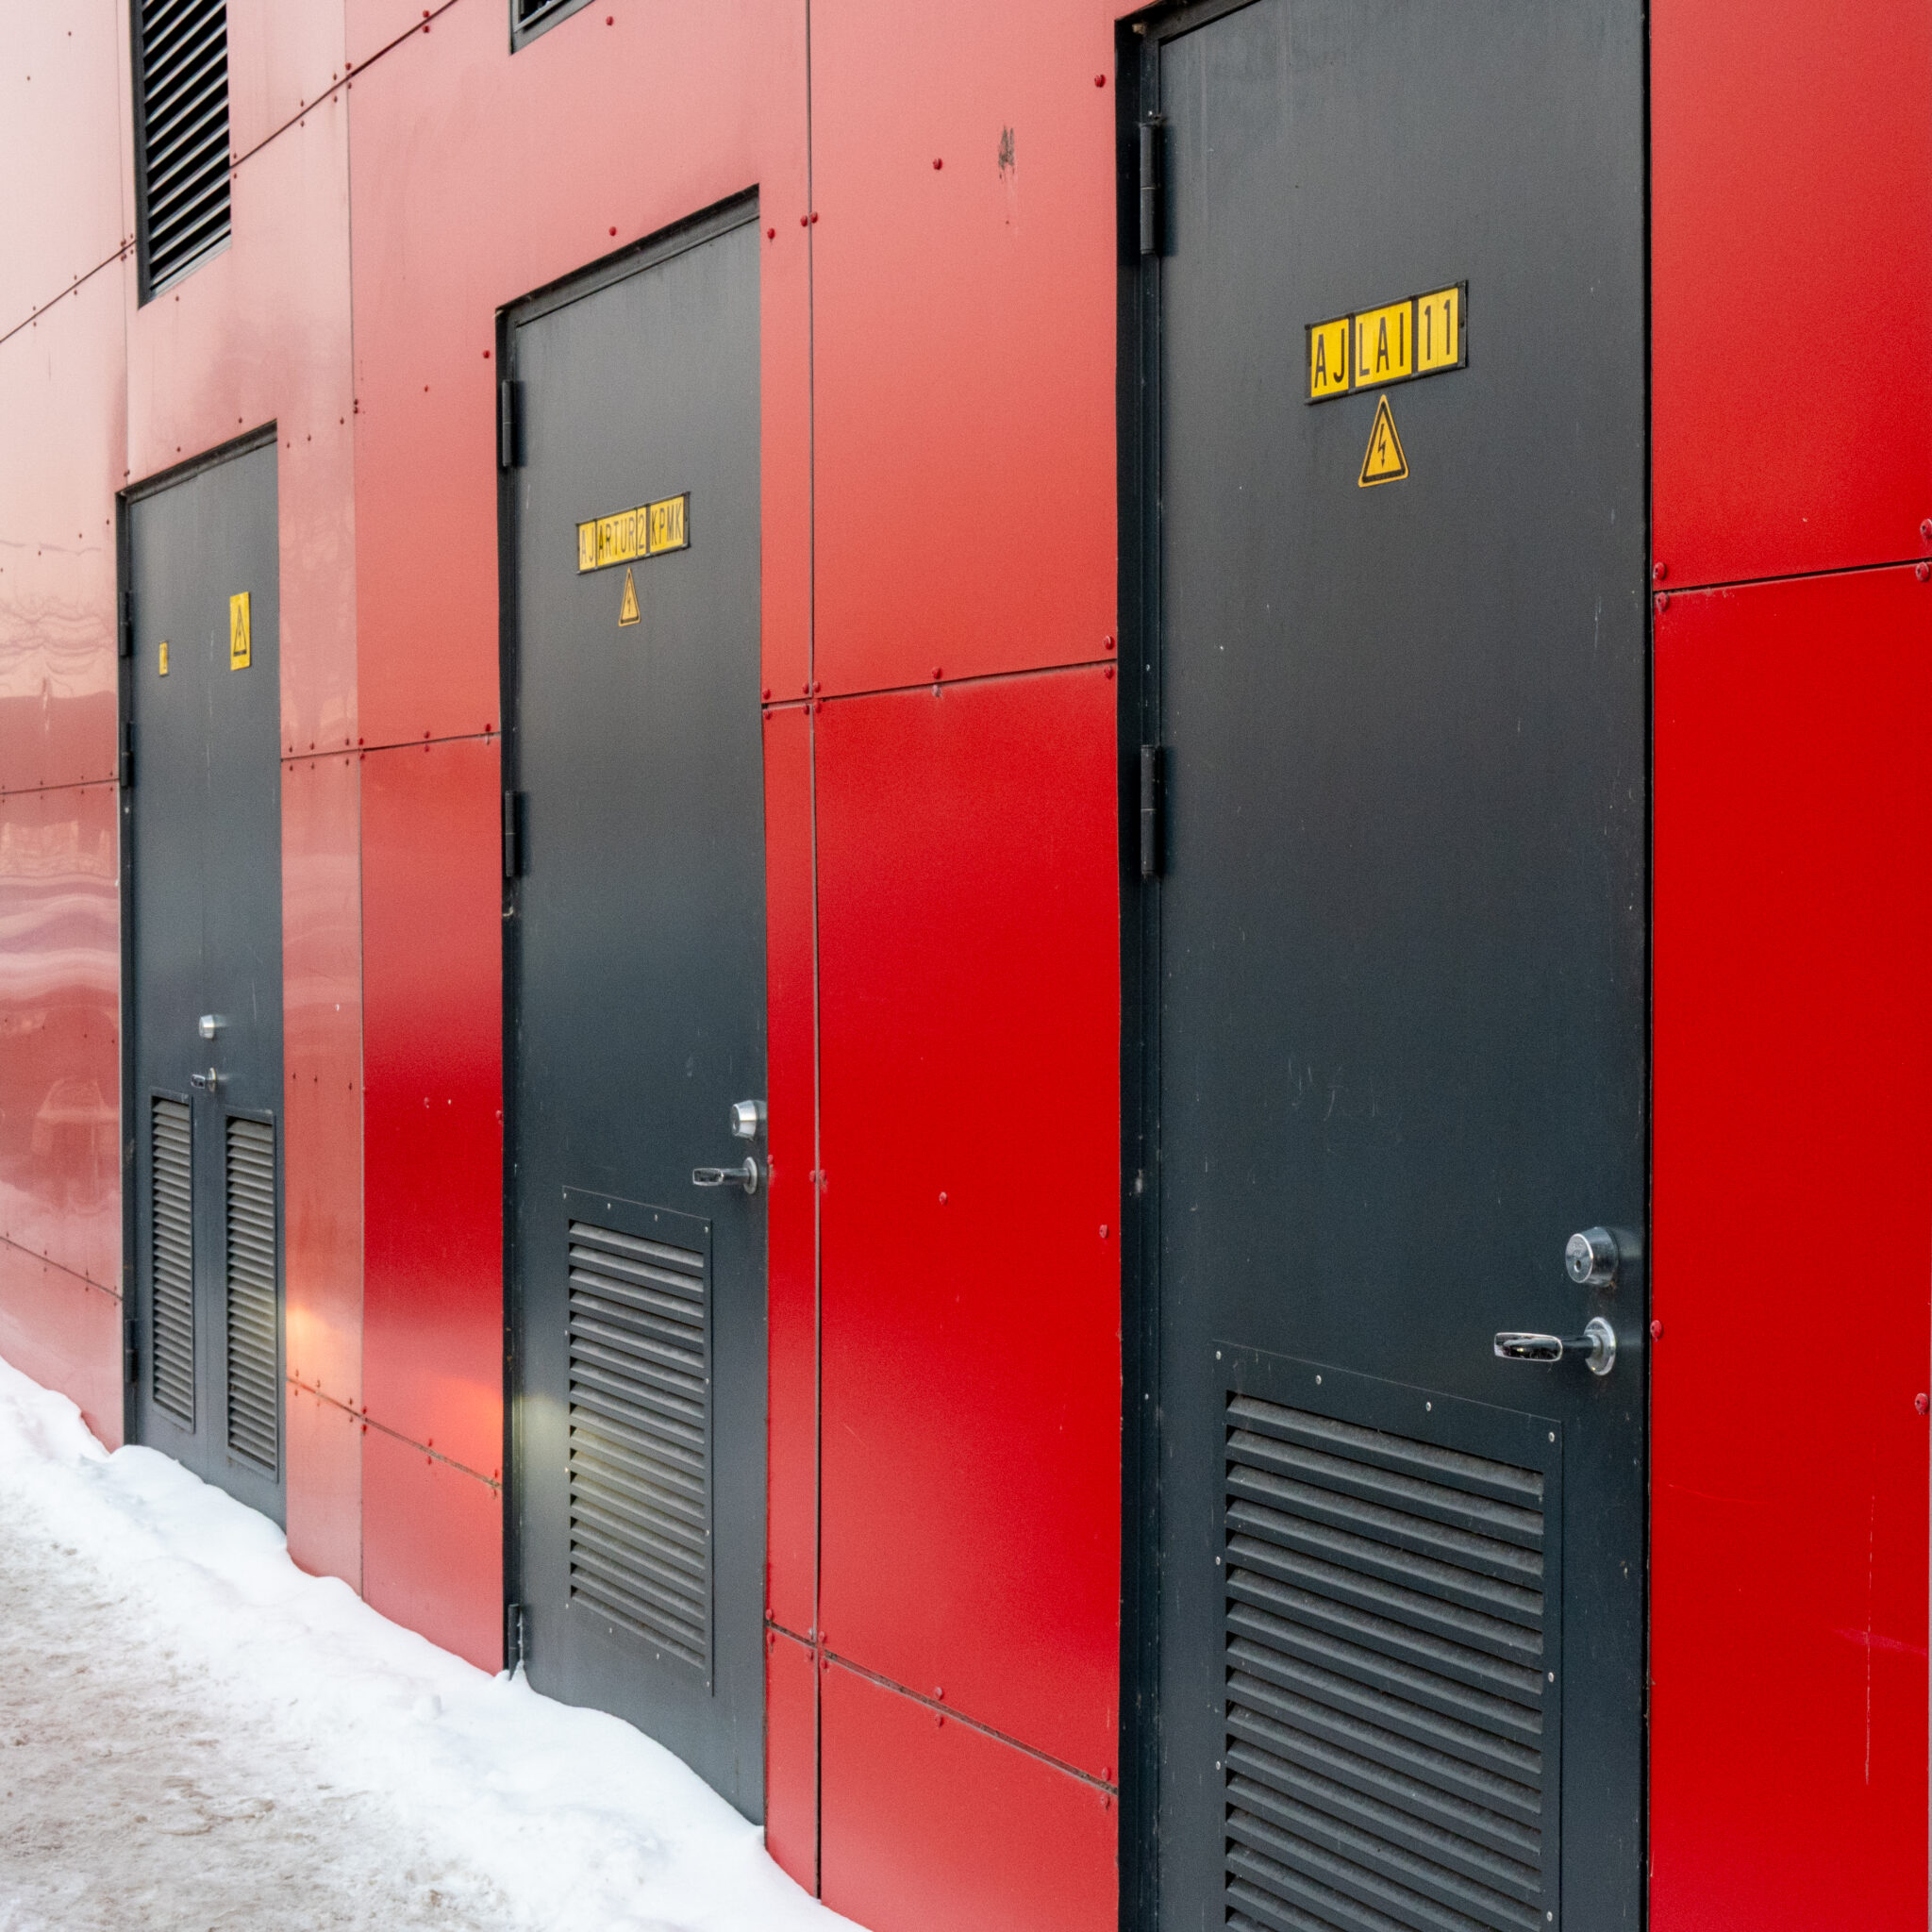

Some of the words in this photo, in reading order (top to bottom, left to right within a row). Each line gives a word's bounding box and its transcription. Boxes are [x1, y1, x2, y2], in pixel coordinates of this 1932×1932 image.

[1314, 329, 1345, 388] AJ
[1359, 312, 1404, 376] LAI
[1424, 299, 1451, 360] 11
[581, 527, 594, 564] AJ
[598, 517, 635, 559] ARTUR
[652, 504, 682, 545] KPMK
